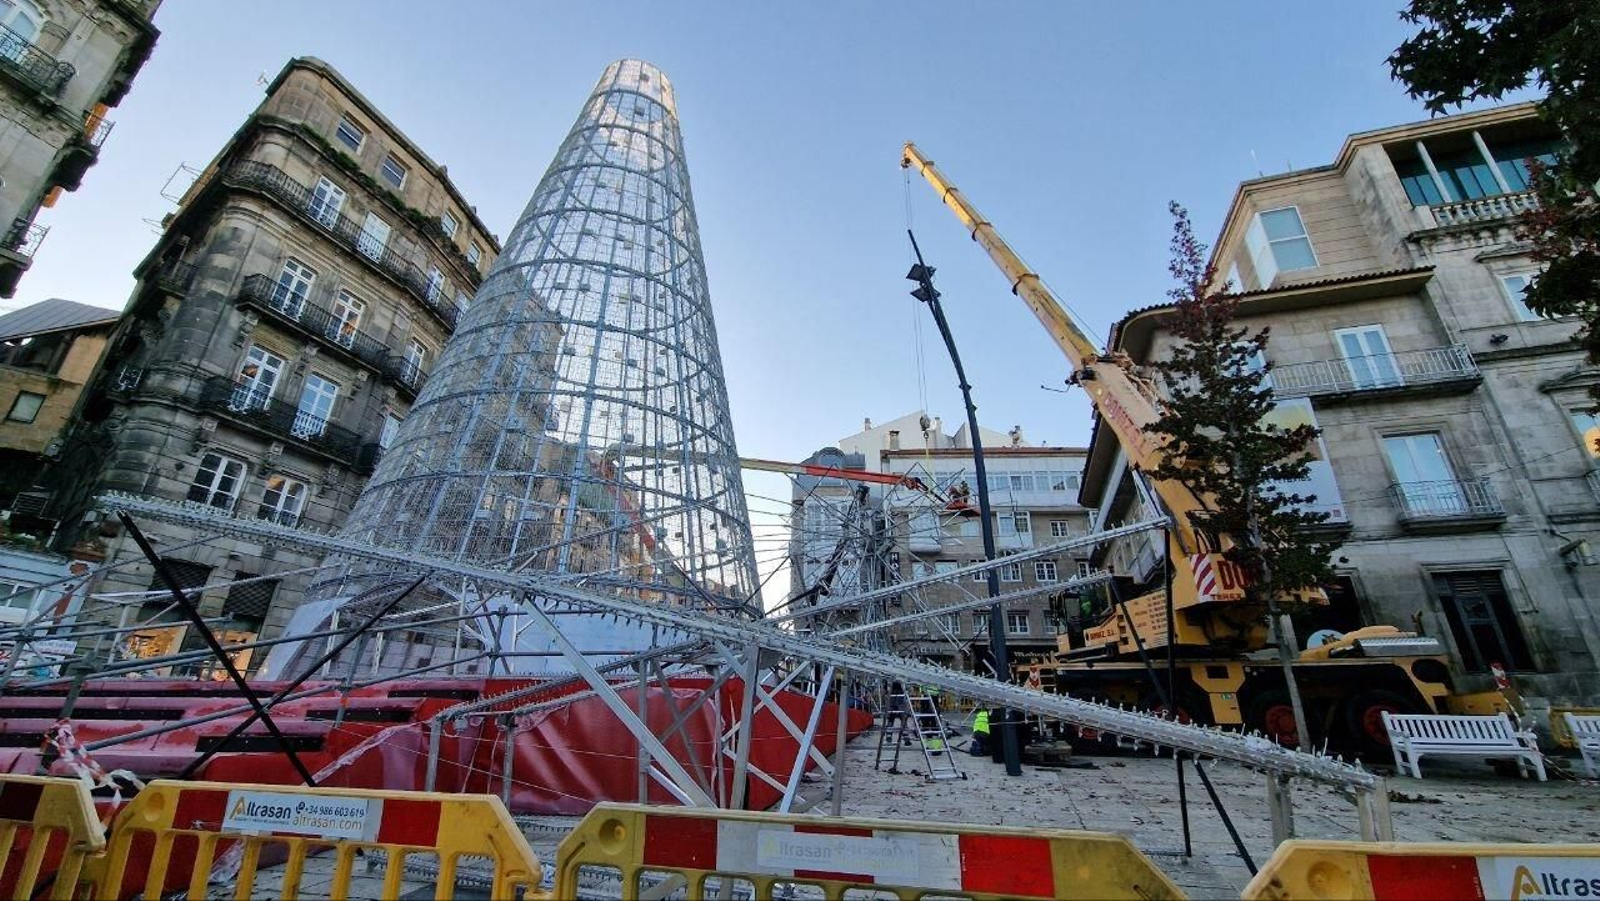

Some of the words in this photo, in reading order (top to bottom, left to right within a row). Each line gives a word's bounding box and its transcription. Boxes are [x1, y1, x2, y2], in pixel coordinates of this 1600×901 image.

[229, 797, 291, 820] Altrasan
[305, 805, 318, 815] +34
[319, 806, 334, 816] 986
[334, 807, 349, 817] 603
[350, 808, 365, 818] 619
[292, 813, 362, 830] altrasan.com
